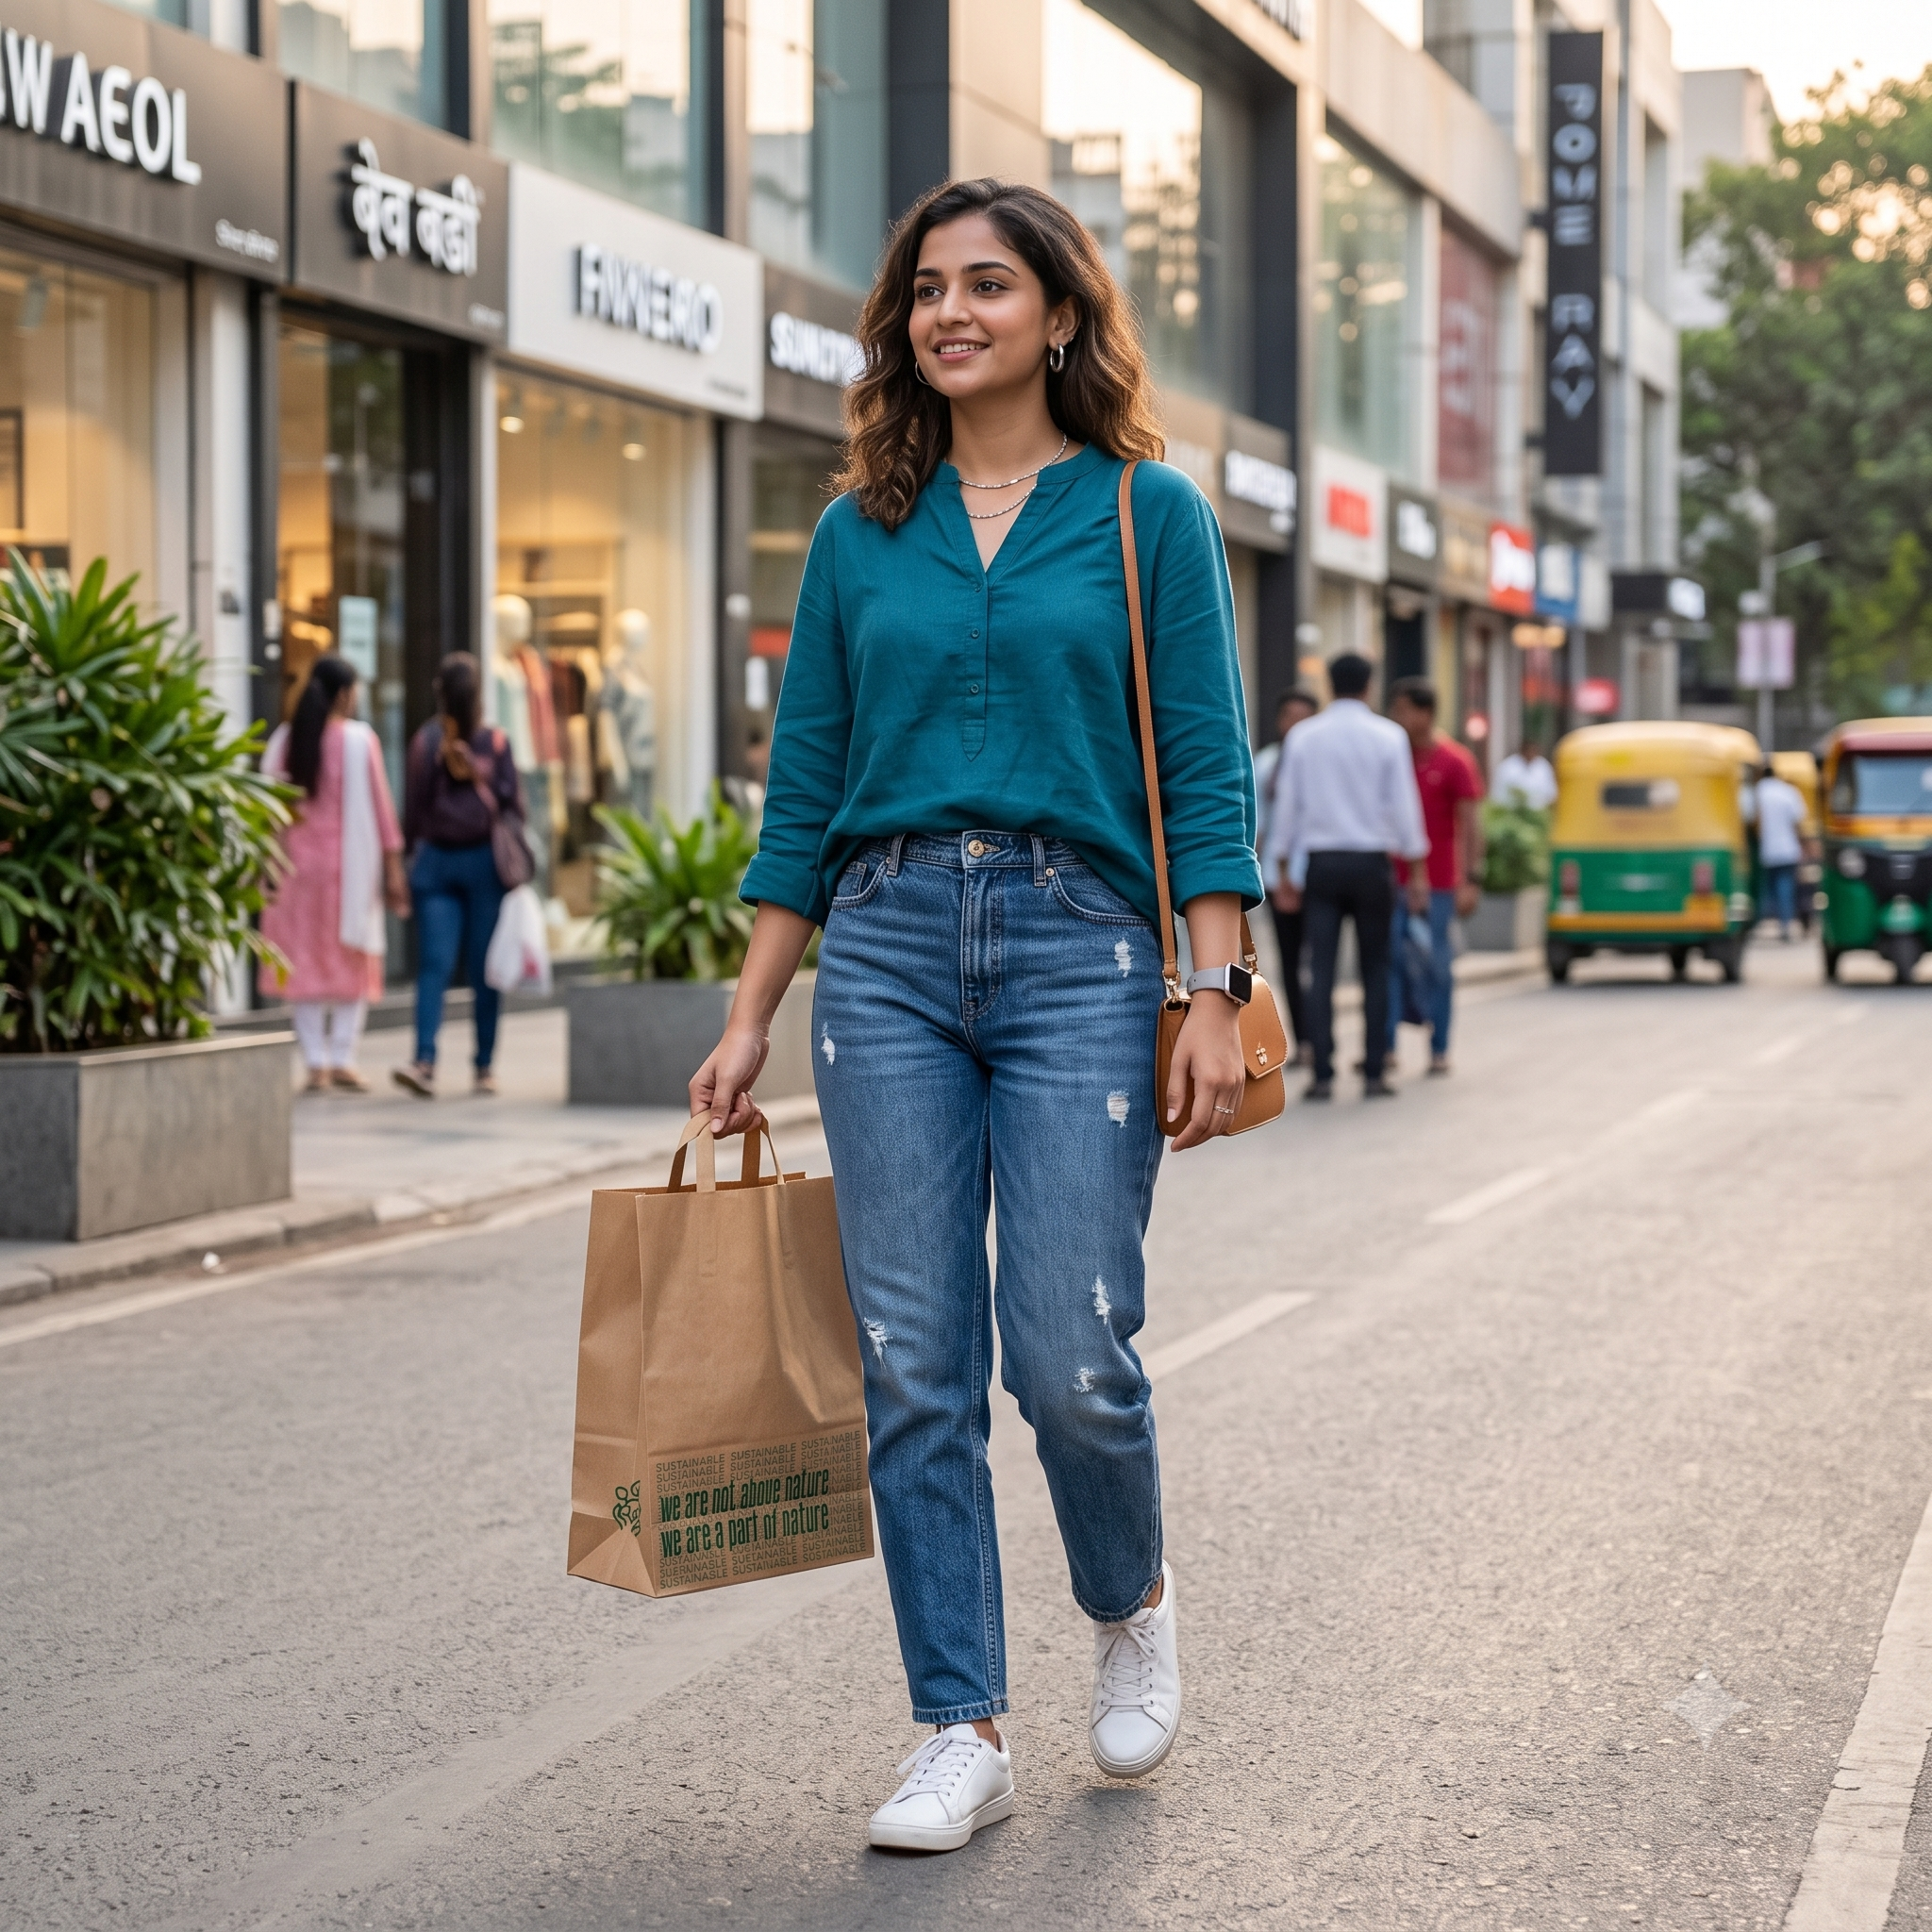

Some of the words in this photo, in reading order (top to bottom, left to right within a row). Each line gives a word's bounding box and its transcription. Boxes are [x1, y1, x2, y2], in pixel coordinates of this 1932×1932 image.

[660, 1495, 681, 1523] we
[685, 1491, 708, 1518] are
[712, 1479, 736, 1514] not
[785, 1468, 829, 1502] nature
[660, 1529, 682, 1557] we
[686, 1524, 711, 1554] are
[715, 1521, 724, 1549] a
[728, 1509, 758, 1552] part
[763, 1506, 777, 1541] of
[782, 1502, 828, 1537] nature
